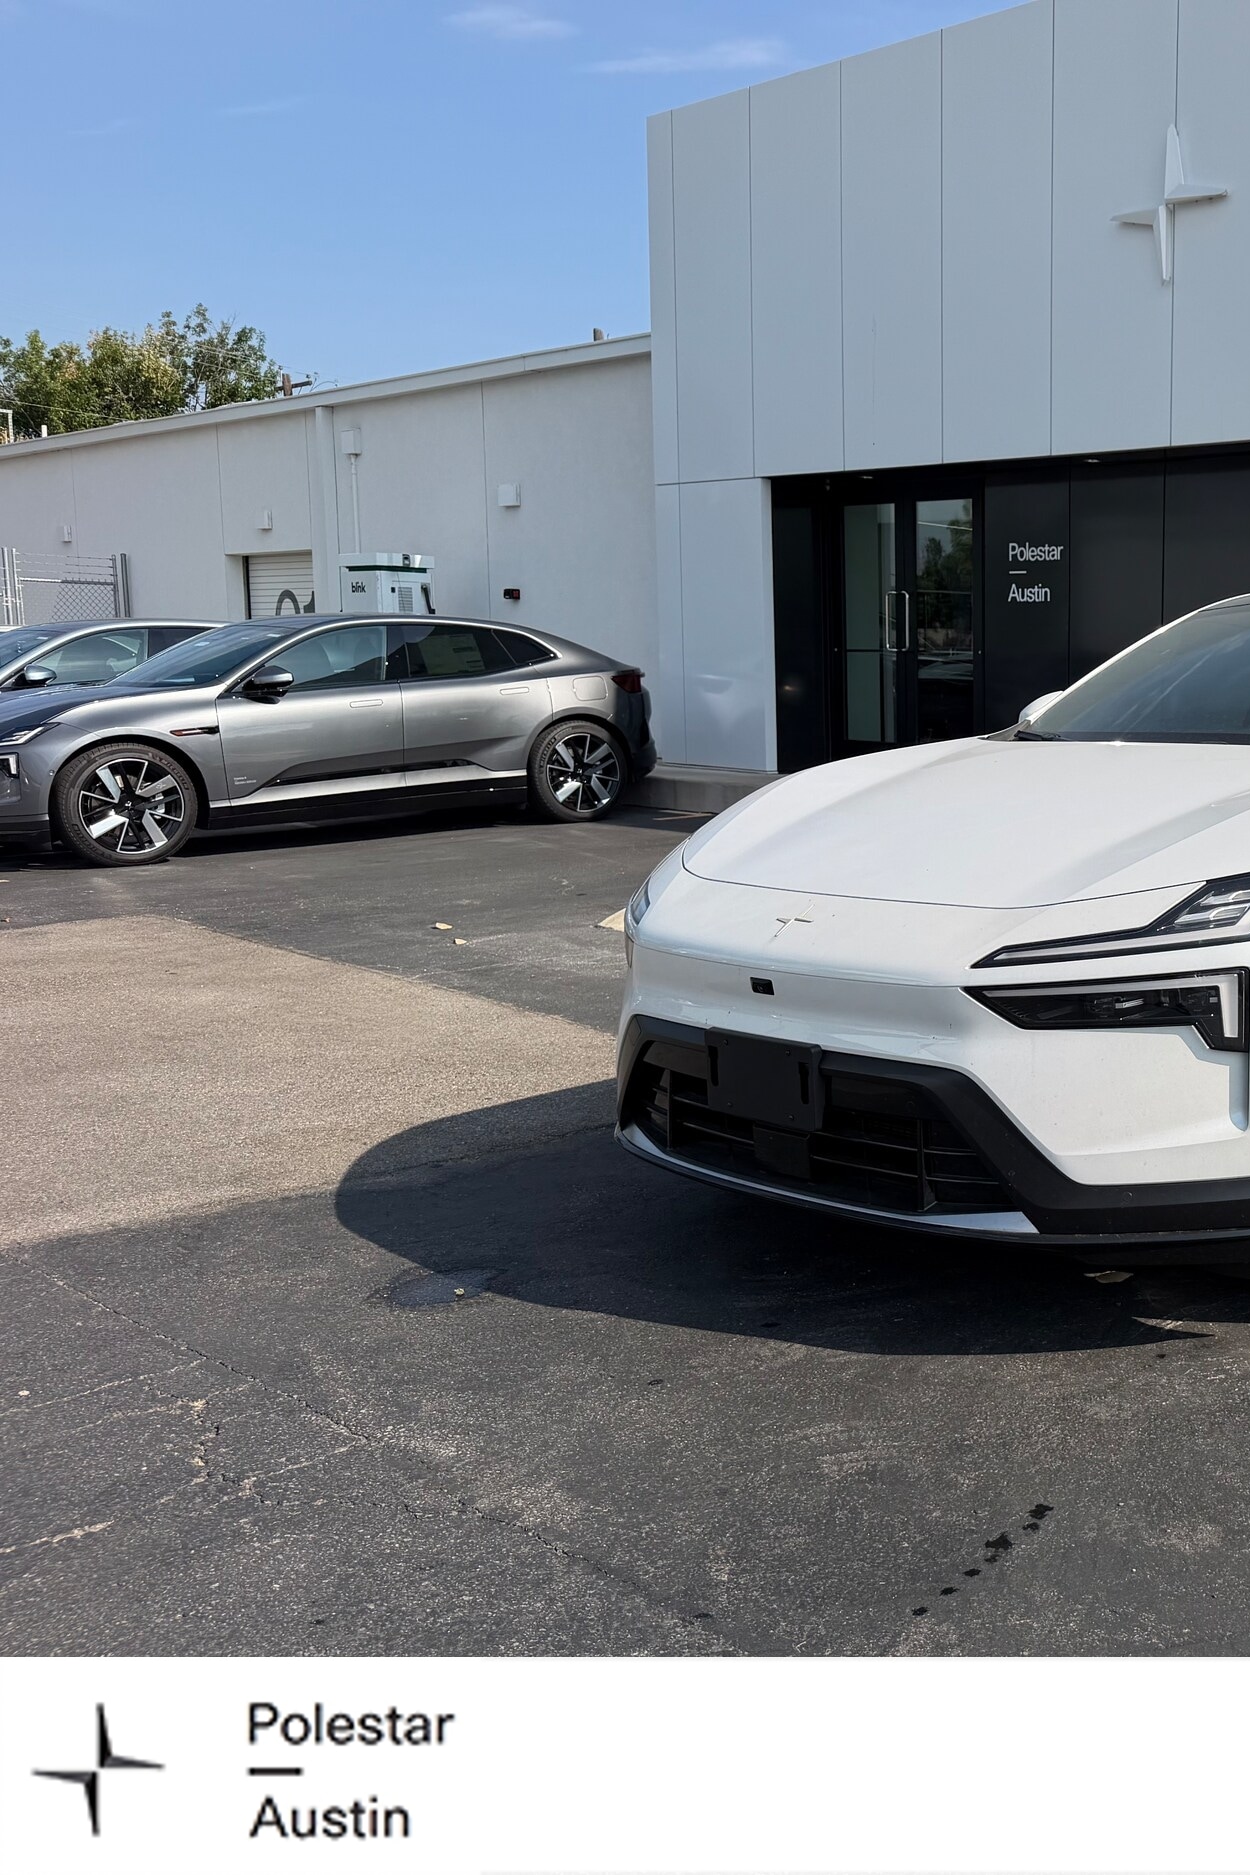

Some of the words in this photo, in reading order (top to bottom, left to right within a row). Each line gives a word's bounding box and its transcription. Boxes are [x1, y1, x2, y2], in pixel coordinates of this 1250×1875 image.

[1008, 542, 1064, 561] Polestar
[351, 582, 366, 593] blink
[1007, 583, 1051, 602] Austin
